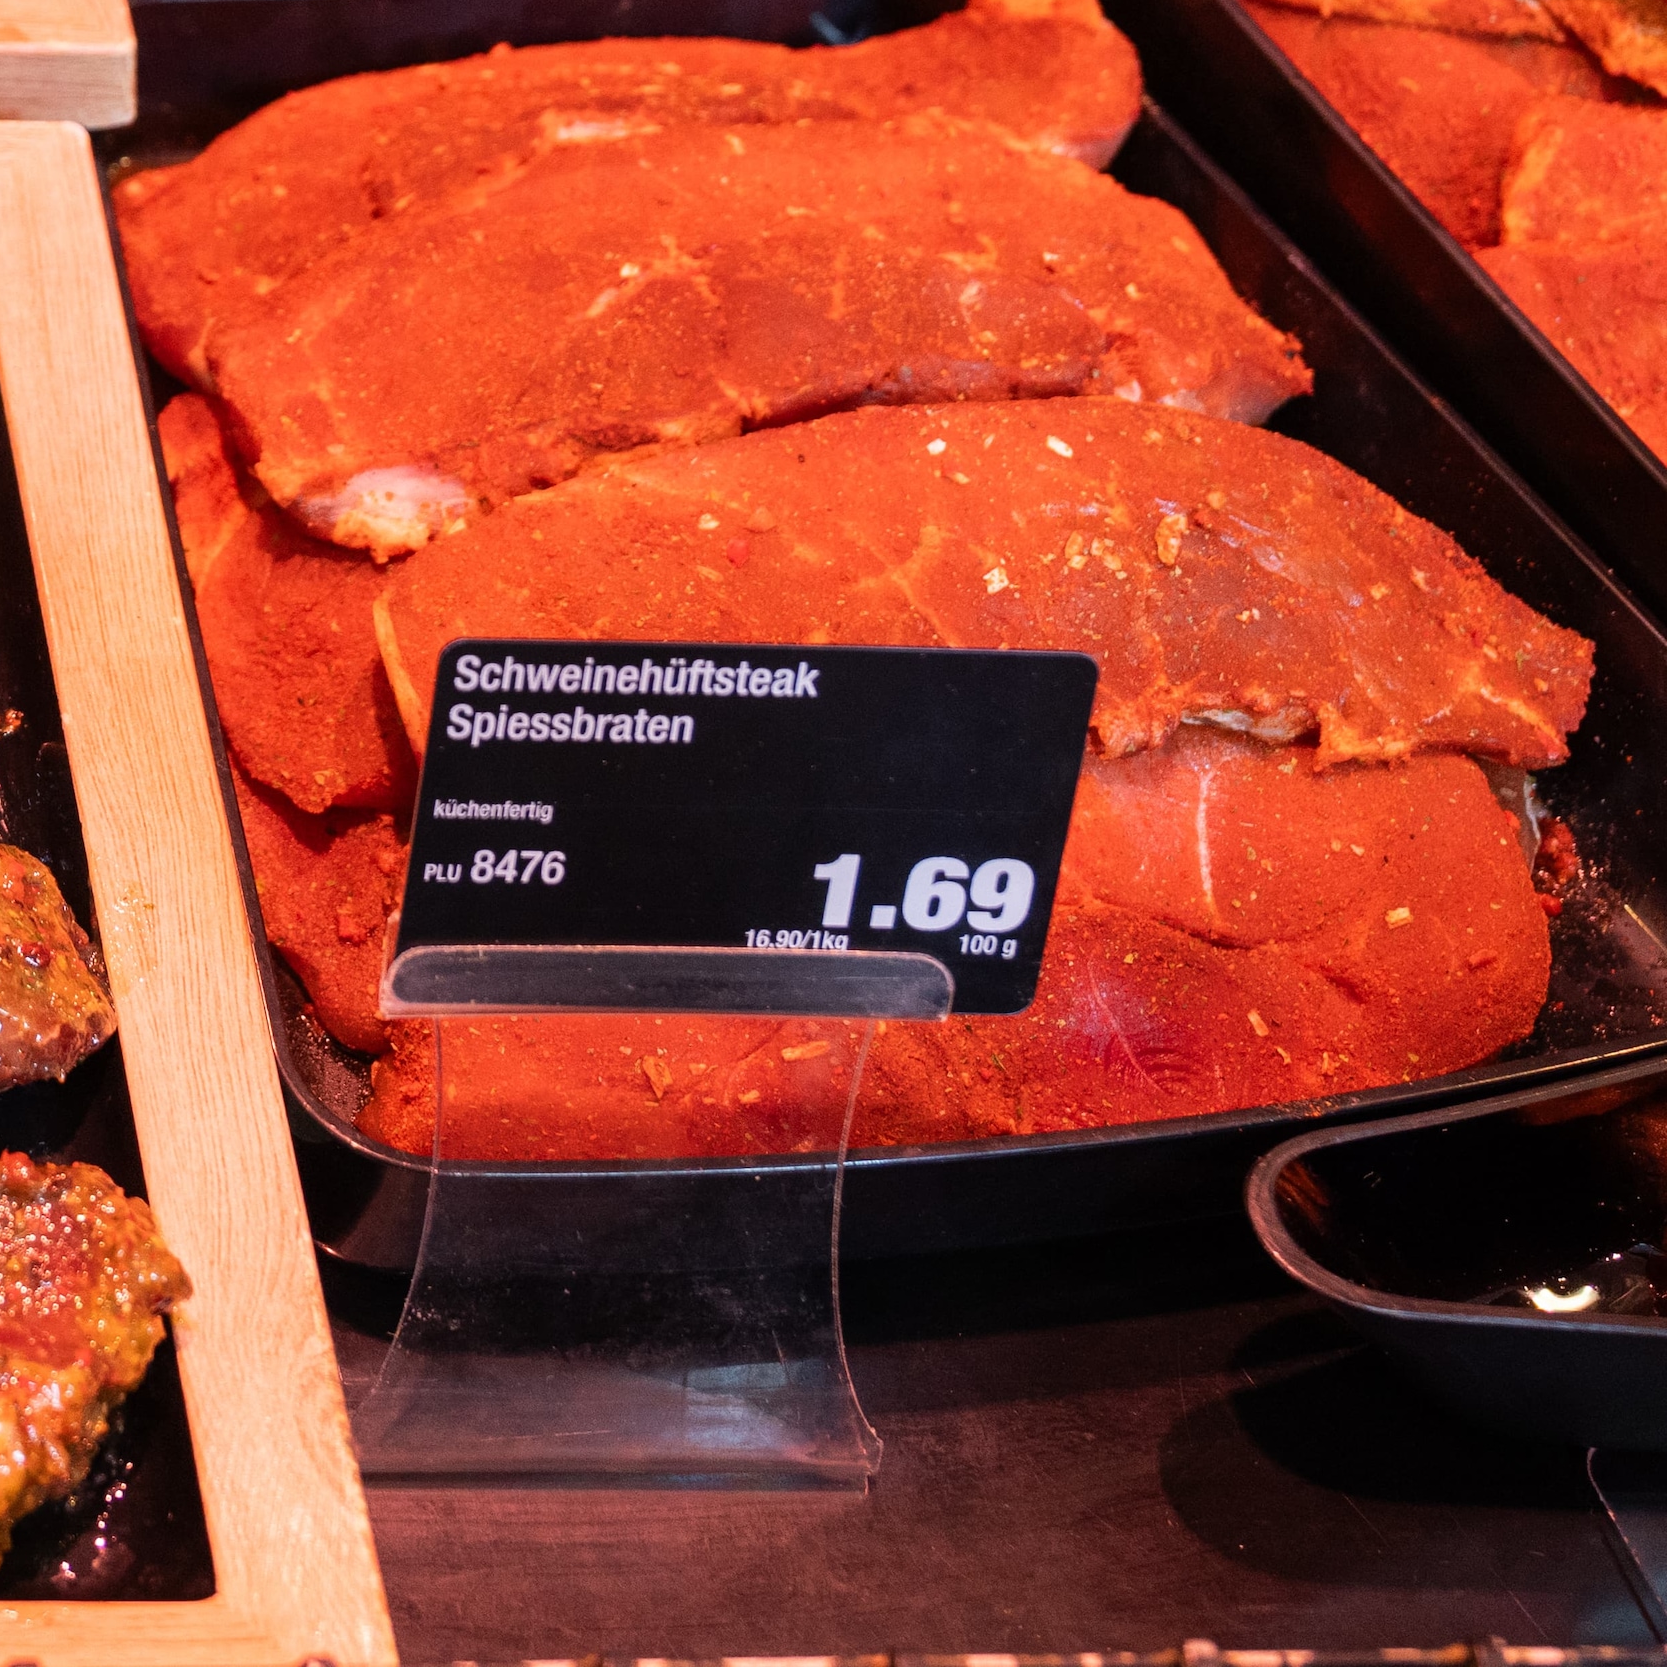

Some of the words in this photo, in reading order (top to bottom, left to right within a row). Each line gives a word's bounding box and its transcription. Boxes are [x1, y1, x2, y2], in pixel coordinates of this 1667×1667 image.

[454, 654, 819, 698] Schweinehüftsteak
[446, 703, 695, 747] Spiessbraten
[434, 799, 553, 824] küchenfertig
[424, 862, 461, 883] PLU
[471, 849, 565, 885] 8476
[812, 854, 1036, 932] 1.69
[745, 929, 848, 951] 16.90/1kg
[959, 934, 996, 956] 100
[999, 938, 1016, 959] g
